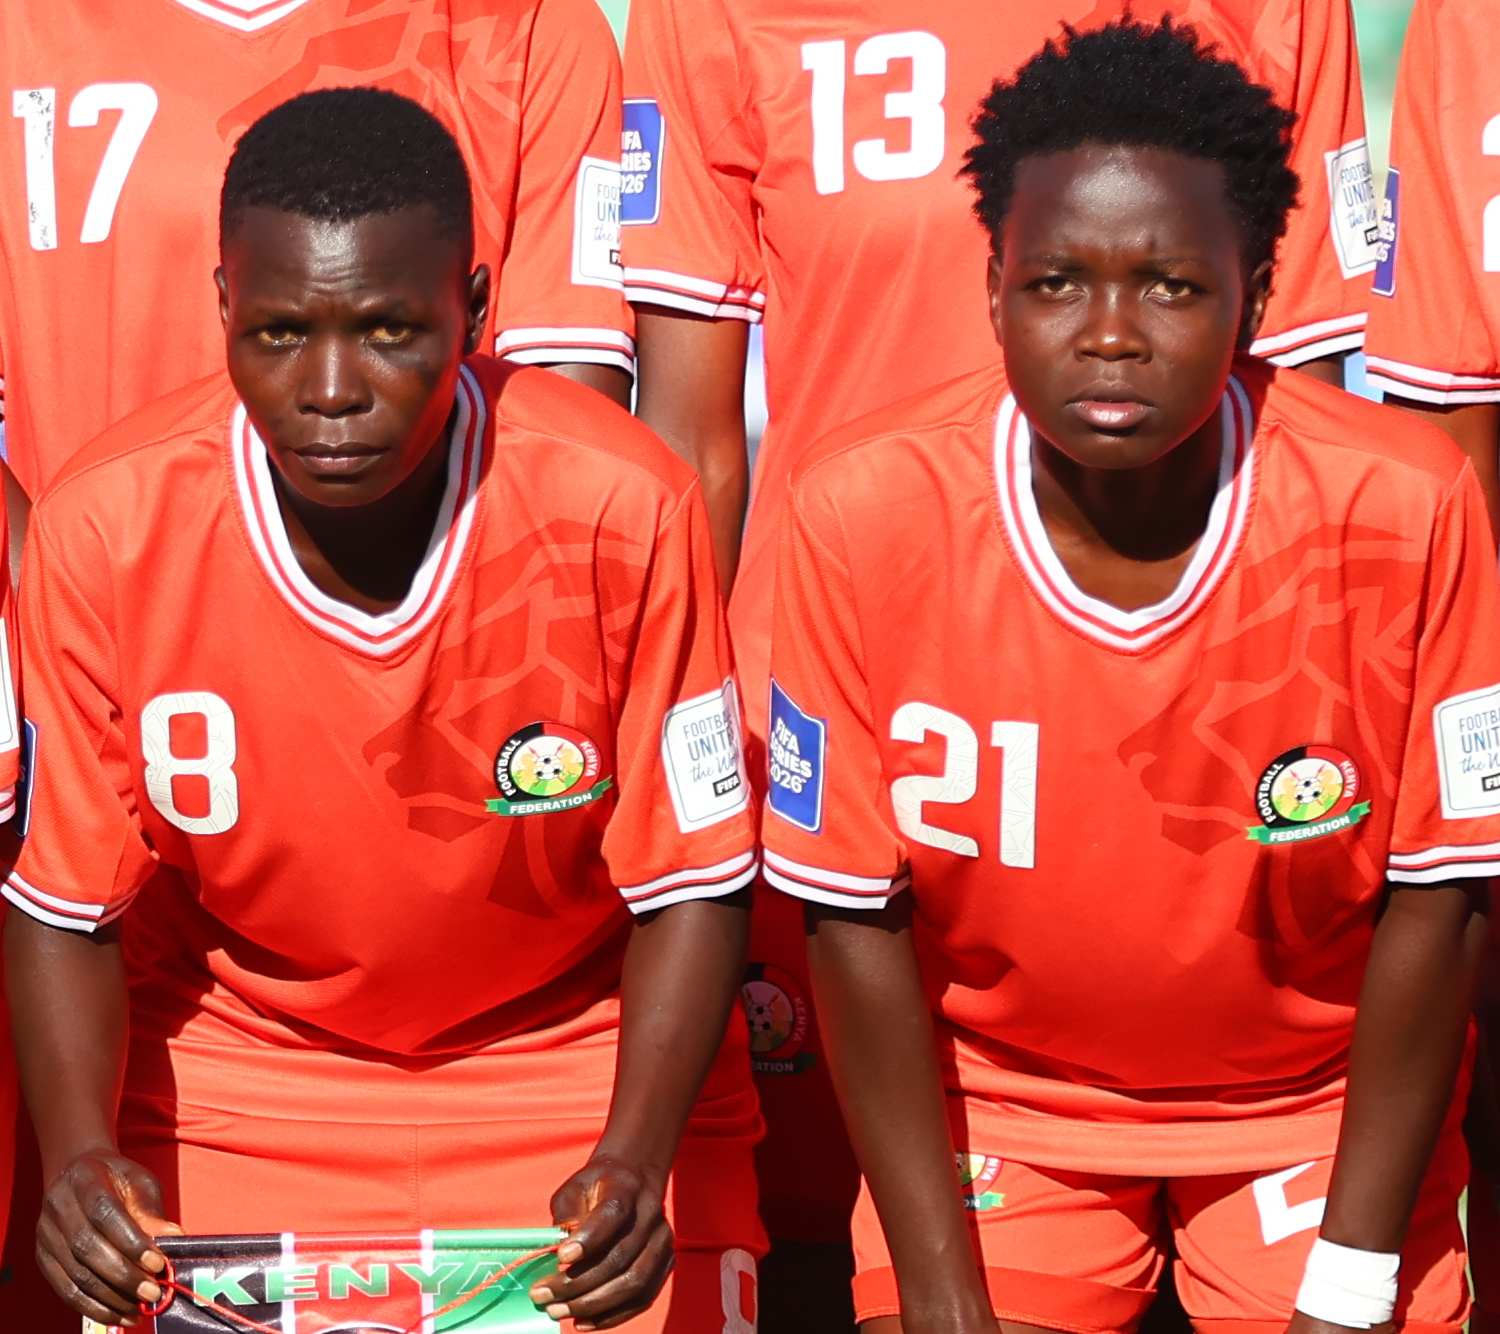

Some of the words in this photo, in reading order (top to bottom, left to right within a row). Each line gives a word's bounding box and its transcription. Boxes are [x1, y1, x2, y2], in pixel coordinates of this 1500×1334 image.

[800, 30, 947, 197] 13
[12, 83, 159, 250] 17
[775, 716, 800, 756] FIFA
[139, 690, 240, 836] 8
[498, 738, 522, 797] FOOTBALL
[579, 740, 599, 779] KENYA
[1339, 759, 1356, 799] KENYA
[1458, 755, 1486, 775] the
[509, 792, 593, 815] FEDERATION
[716, 775, 739, 794] FIFA
[889, 701, 1039, 870] 21
[1258, 762, 1285, 823] FOOTBALL
[1269, 815, 1351, 843] FEDERATION
[190, 1260, 524, 1307] KENYA
